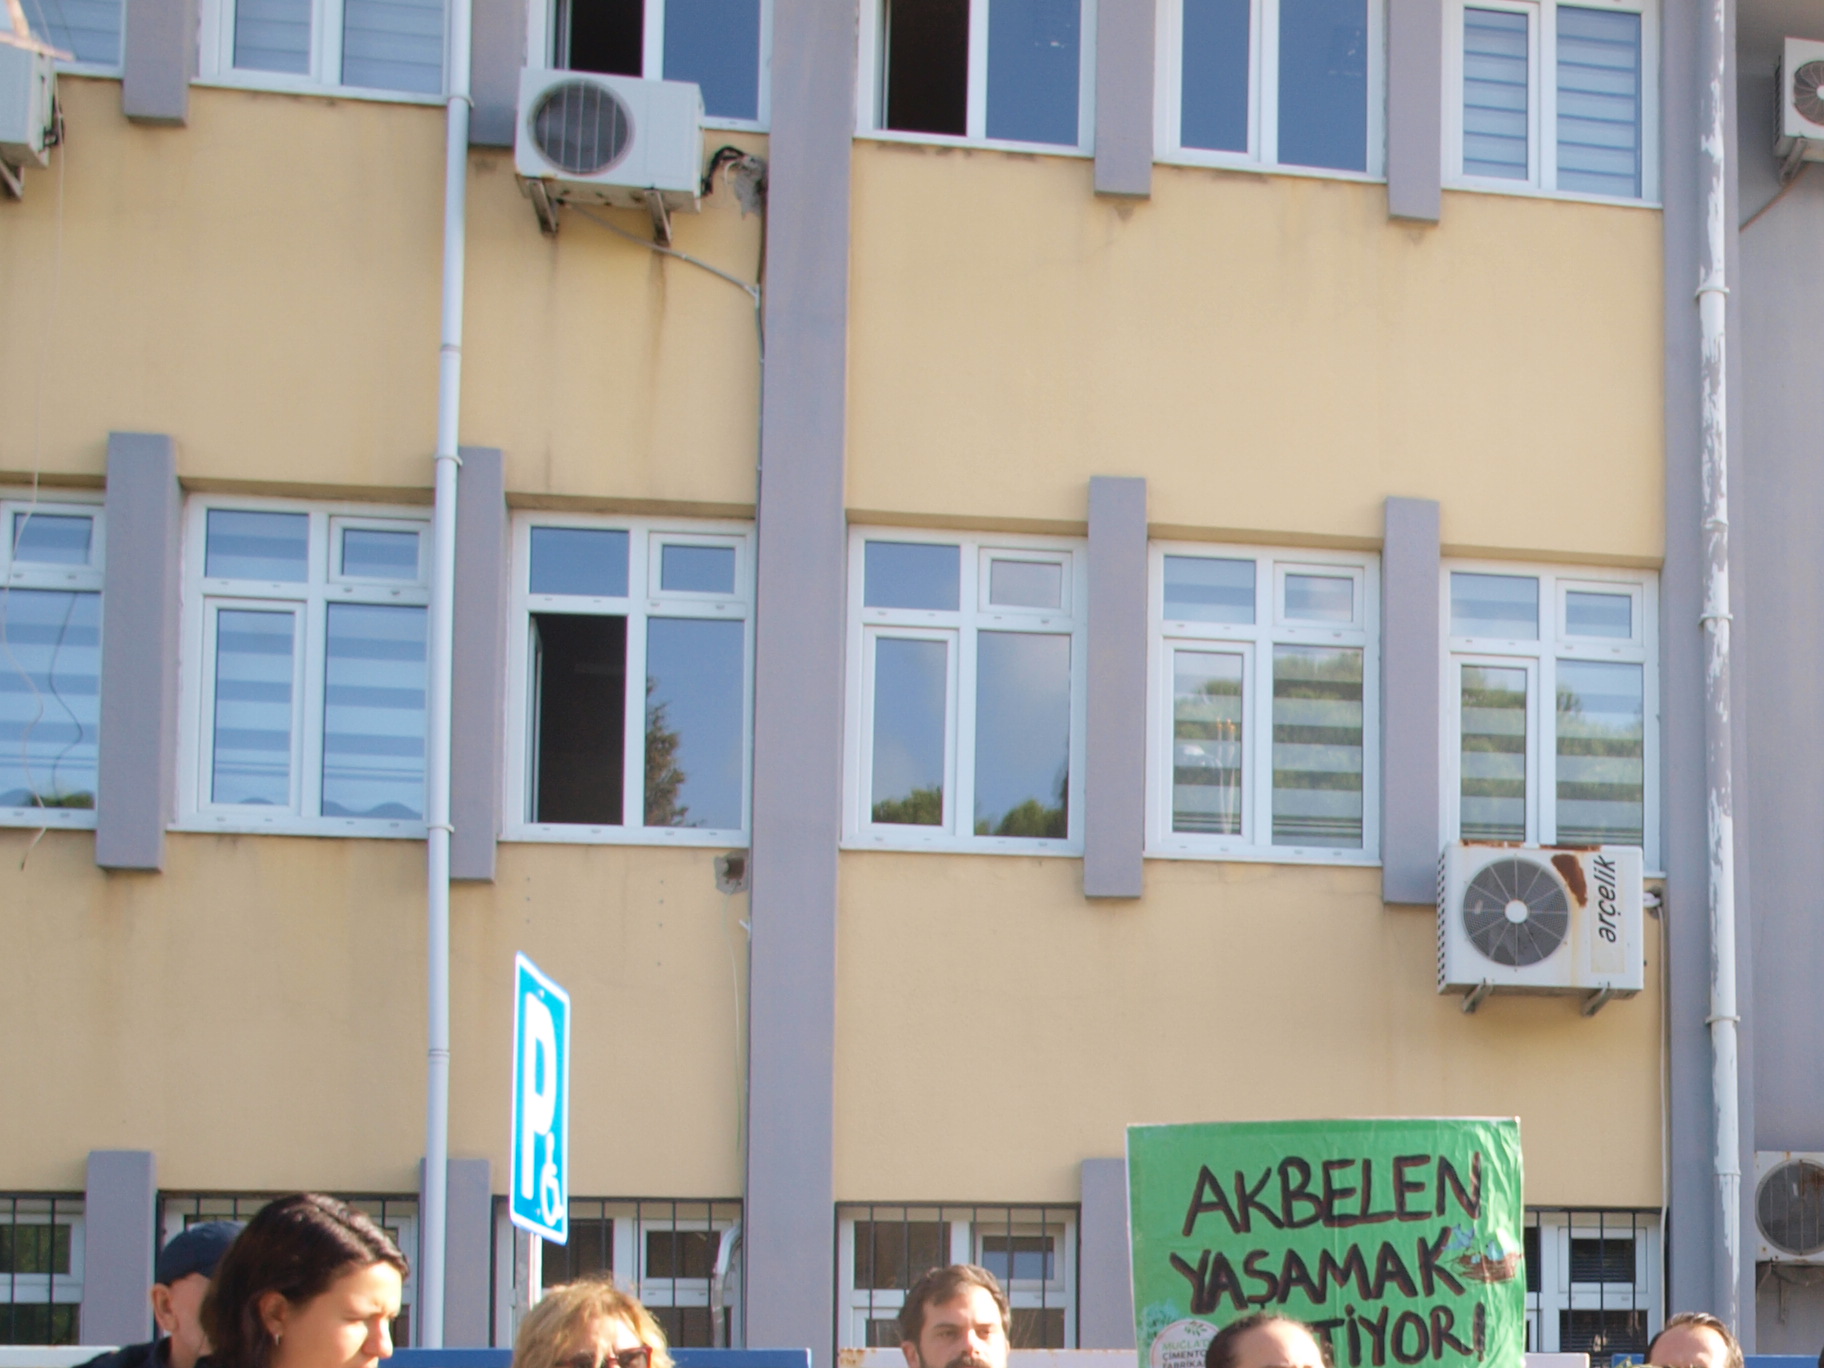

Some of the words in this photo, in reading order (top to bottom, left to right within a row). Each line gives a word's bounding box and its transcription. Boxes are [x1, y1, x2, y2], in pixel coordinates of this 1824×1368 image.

[1593, 855, 1621, 944] arçelik
[521, 991, 558, 1200] P
[1182, 1152, 1482, 1237] AKBELEN
[1169, 1226, 1467, 1314] YAŞAMAK
